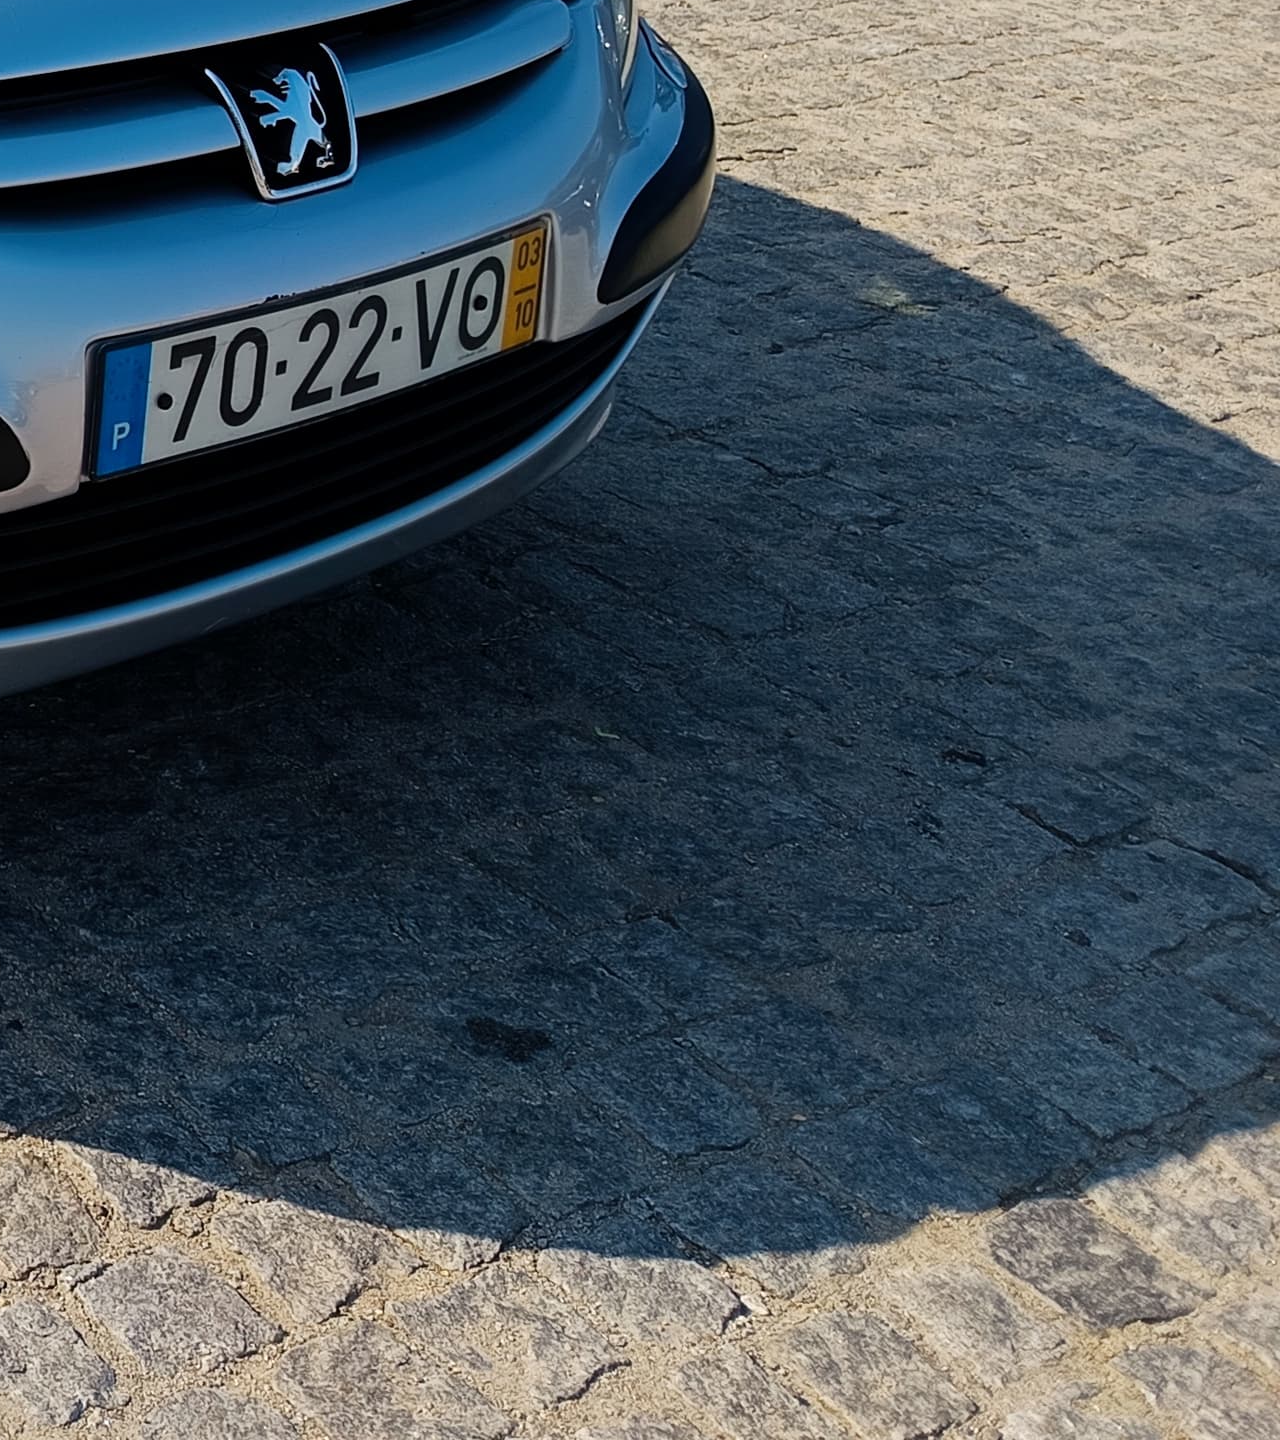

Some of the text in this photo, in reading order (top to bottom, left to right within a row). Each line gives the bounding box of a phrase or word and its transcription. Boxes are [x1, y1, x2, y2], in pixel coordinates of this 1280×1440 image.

[517, 236, 541, 271] 03
[515, 299, 534, 331] 10
[112, 422, 130, 451] P
